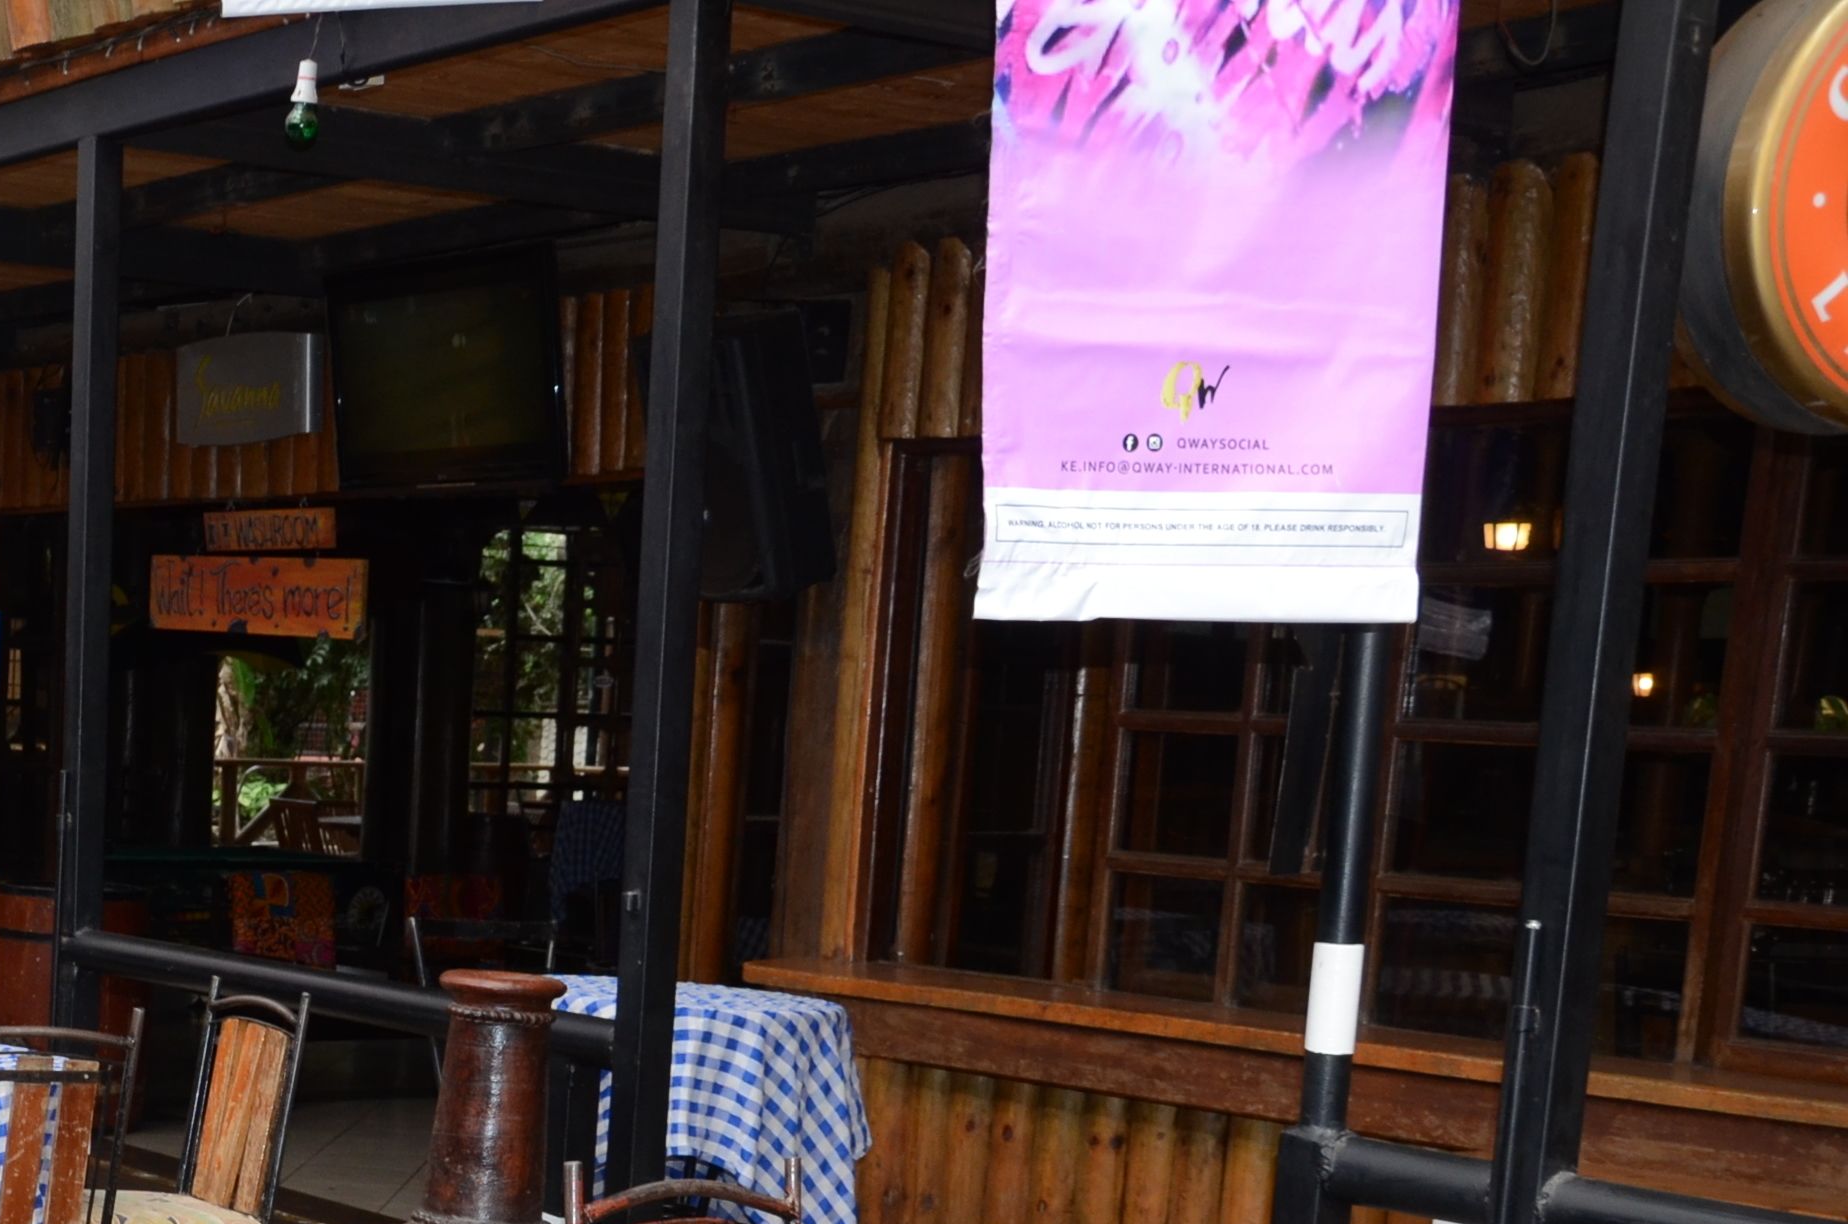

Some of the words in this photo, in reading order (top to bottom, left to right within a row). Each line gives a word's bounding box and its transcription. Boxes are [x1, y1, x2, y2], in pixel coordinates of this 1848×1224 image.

[1176, 437, 1270, 451] QWAYSOCIAL
[1060, 459, 1334, 476] KE.INFO@QWAY-INTERNATIONAL.COM
[236, 514, 321, 549] WASHROOM
[1105, 521, 1120, 530] FOR
[1198, 523, 1213, 531] THE
[1237, 523, 1248, 531] OF
[1264, 524, 1297, 532] PLEASE
[1300, 524, 1325, 532] DRINK
[209, 560, 274, 620] There's
